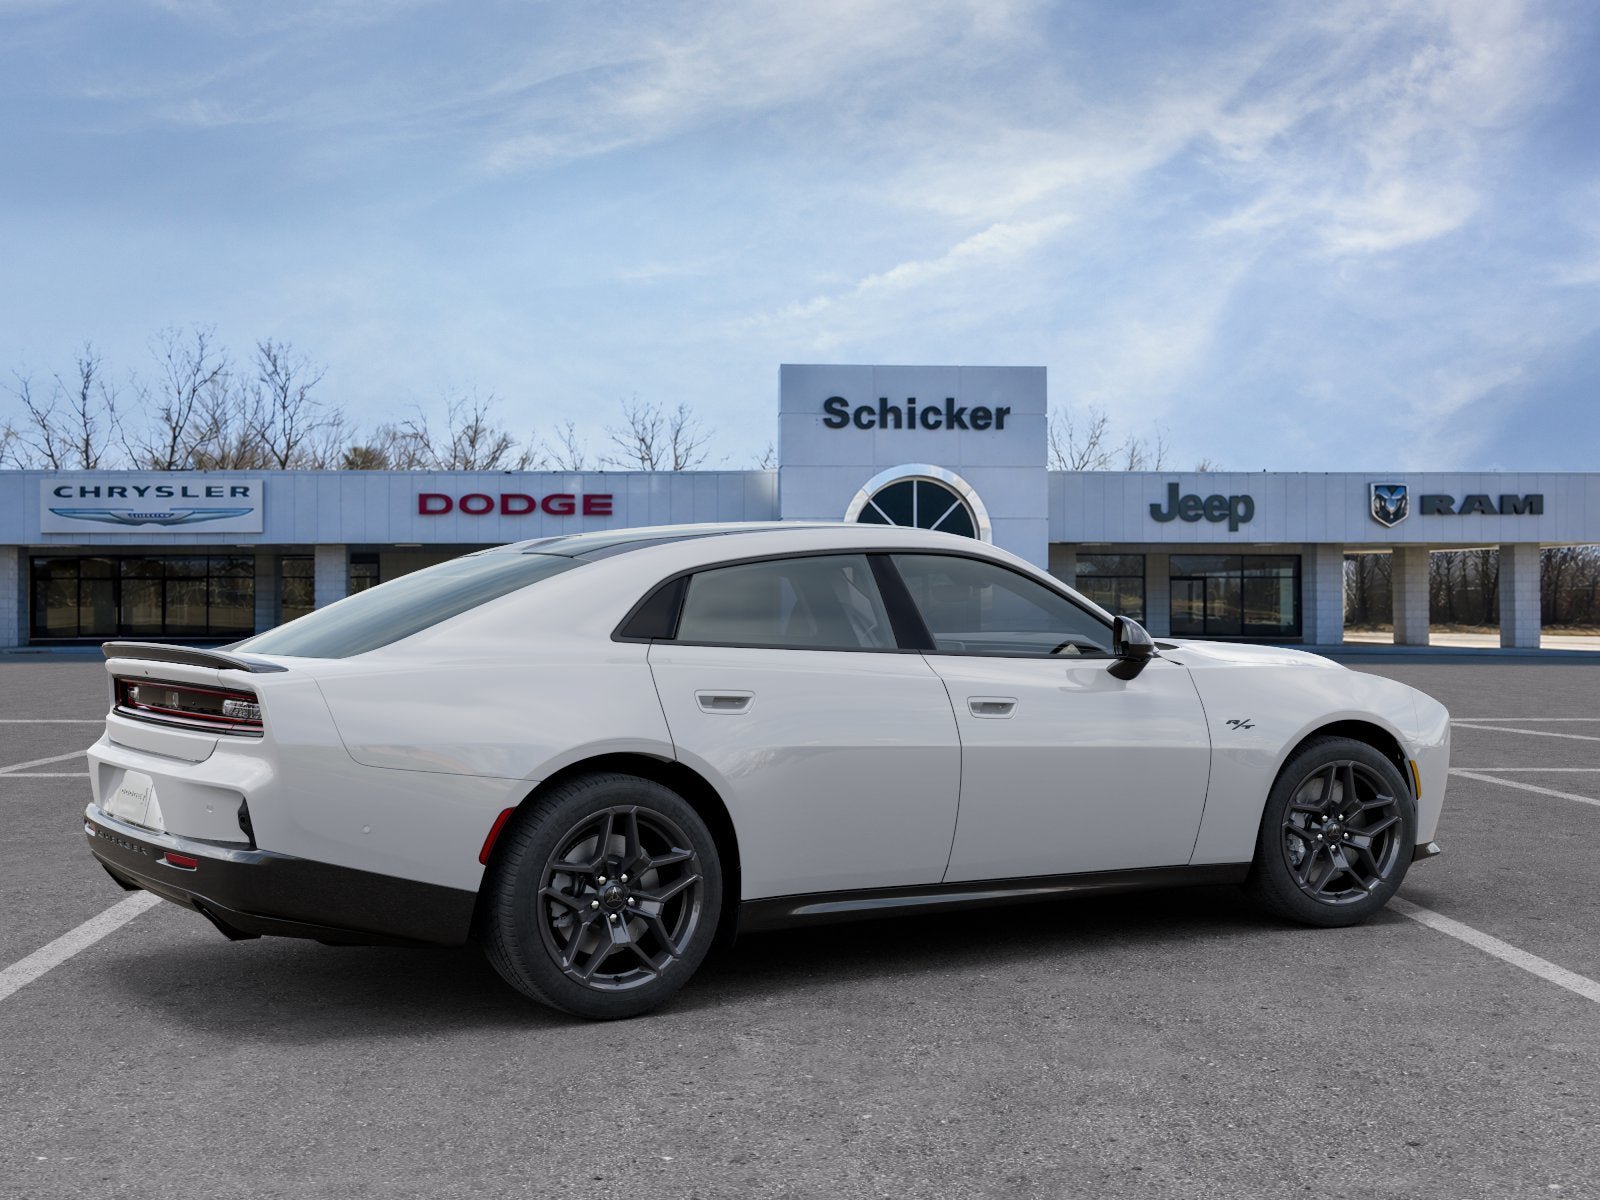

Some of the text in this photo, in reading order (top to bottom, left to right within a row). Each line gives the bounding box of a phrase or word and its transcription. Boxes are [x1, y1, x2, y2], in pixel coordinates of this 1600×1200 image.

[823, 396, 1011, 430] Schicker
[53, 485, 250, 498] CHRYSLER
[418, 493, 613, 516] DODGE
[1149, 482, 1255, 532] Jeep
[1419, 493, 1544, 516] RAM
